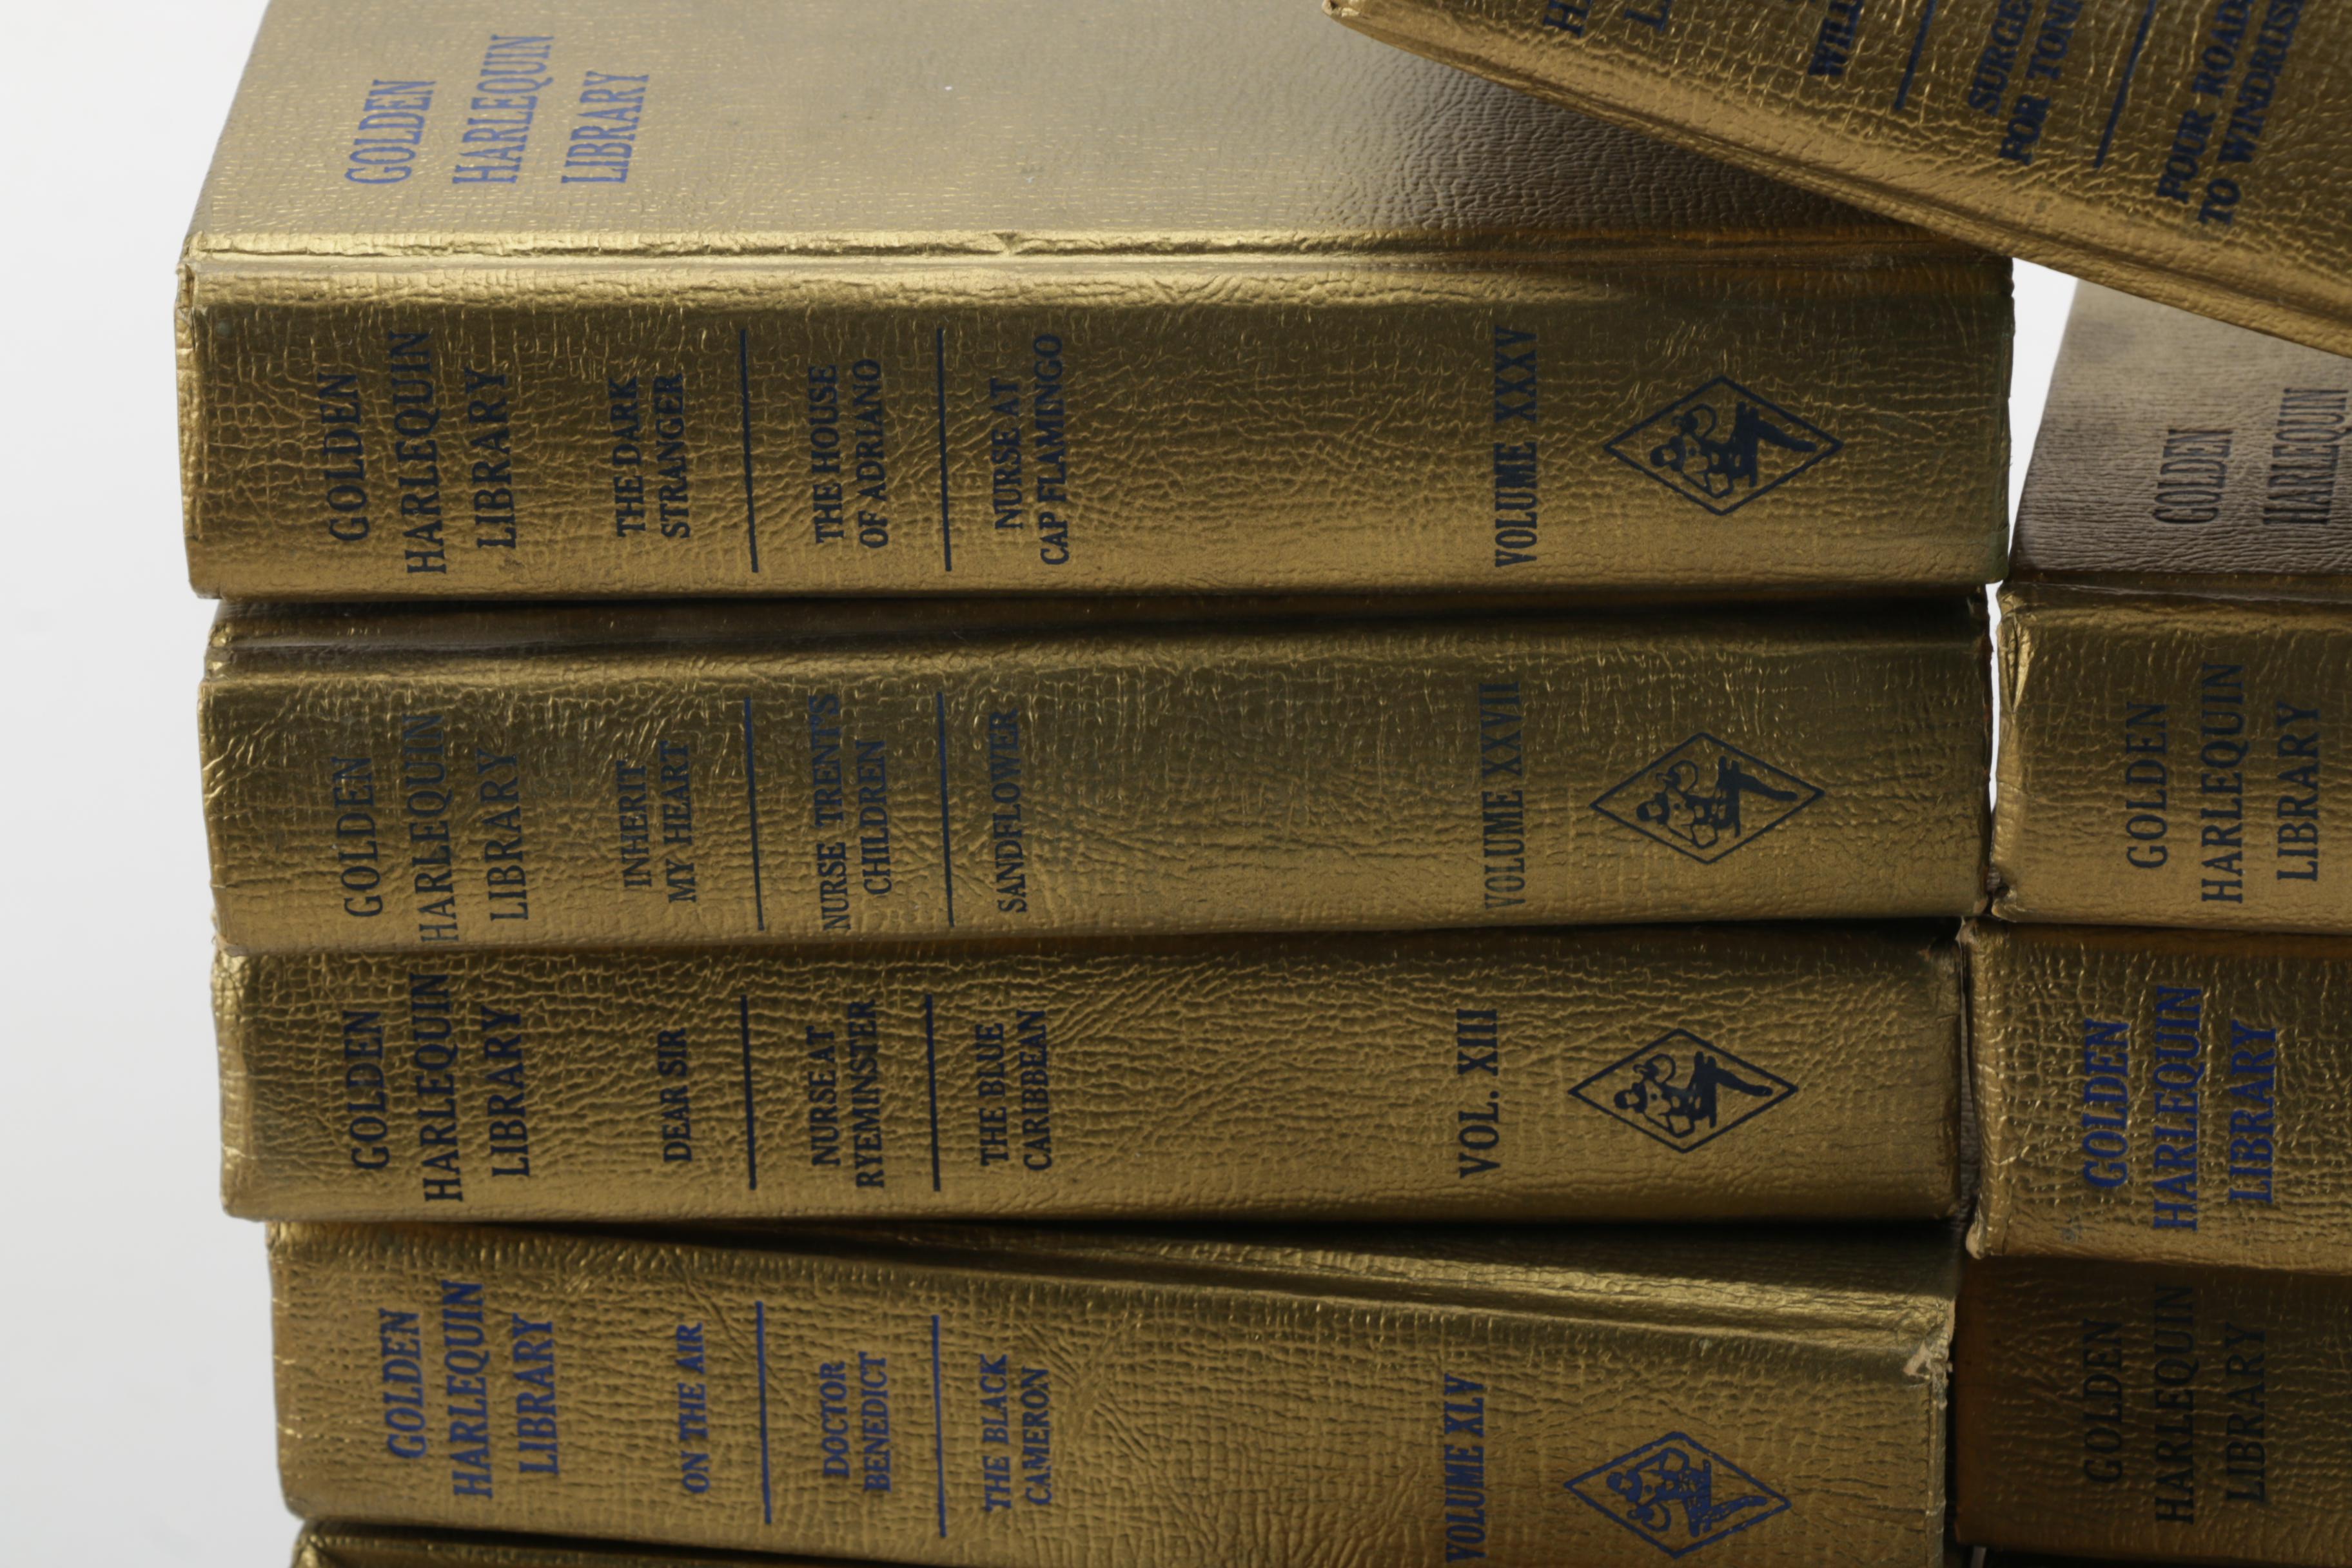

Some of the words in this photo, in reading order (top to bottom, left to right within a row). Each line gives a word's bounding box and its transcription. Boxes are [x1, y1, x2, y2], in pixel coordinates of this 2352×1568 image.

[344, 79, 436, 184] GOLDEN
[452, 34, 554, 184] HARLEQUIN
[561, 71, 649, 184] LIBRARY
[1999, 95, 2051, 165] FOR
[2156, 110, 2216, 204] FOUR
[2193, 0, 2253, 99] ROAD
[2217, 0, 2305, 164] WINDRUS
[2198, 179, 2242, 226] TO
[608, 376, 642, 466] DARK
[808, 364, 840, 474] HOUSE
[852, 358, 887, 502] ADRIANO
[990, 378, 1021, 418] AT
[1034, 333, 1067, 503] FLAMINGO
[1494, 325, 1537, 423] XXXV
[317, 371, 370, 542] GOLDEN
[389, 329, 447, 574] HARLEQUIN
[464, 367, 516, 549] LIBRARY
[612, 475, 646, 538] THE
[653, 373, 691, 538] STRANGER
[813, 482, 845, 544] THE
[992, 427, 1023, 530] NURSE
[1494, 442, 1538, 567] VOLUME
[2152, 429, 2233, 524] GOLDEN
[2262, 388, 2352, 525] HARLEQUIN
[858, 510, 889, 548] OF
[1039, 511, 1070, 565] CAP
[808, 693, 844, 828] TRENT'S
[1479, 681, 1523, 777] XXVII
[2126, 701, 2168, 868] GOLDEN
[2200, 662, 2249, 903] HARLEQUIN
[2277, 701, 2318, 881] LIBRARY
[331, 756, 384, 917] GOLDEN
[402, 714, 458, 942] HARLEQUIN
[476, 748, 529, 921] LIBRARY
[616, 760, 652, 888] INHERIT
[660, 740, 692, 846] HEART
[855, 740, 892, 895] CHILDREN
[989, 709, 1027, 913] SANDFLOWER
[1482, 789, 1525, 909] VOLUME
[665, 858, 696, 903] MY
[817, 841, 851, 931] NURSE
[342, 1010, 390, 1170] GOLDEN
[409, 972, 463, 1202] HARLEQUIN
[481, 1005, 530, 1177] LIBRARY
[656, 1028, 688, 1077] SIR
[805, 1025, 836, 1064] AT
[848, 998, 885, 1189] RYEMINSTER
[975, 1023, 1006, 1099] BLUE
[1016, 1009, 1053, 1171] CARIBBEAN
[1456, 1008, 1498, 1075] XIII
[2082, 1019, 2130, 1188] GOLDEN
[660, 1084, 692, 1162] DEAR
[808, 1070, 841, 1166] NURSE
[979, 1106, 1009, 1166] THE
[1458, 1090, 1500, 1179] VOL.
[2153, 986, 2205, 1231] HARLEQUIN
[2229, 1019, 2277, 1204] LIBRARY
[378, 1308, 427, 1459] GOLDEN
[441, 1280, 493, 1499] HARLEQUIN
[513, 1313, 560, 1475] LIBRARY
[676, 1322, 706, 1375] AIR
[678, 1382, 709, 1440] THE
[979, 1354, 1010, 1445] BLACK
[1444, 1373, 1485, 1438] XLV
[2083, 1318, 2122, 1484] GOLDEN
[2155, 1284, 2199, 1524] HARLEQUIN
[680, 1451, 710, 1494] ON
[819, 1360, 850, 1478] DOCTOR
[859, 1351, 892, 1492] BENEDICT
[1021, 1366, 1052, 1505] CAMERON
[2224, 1321, 2266, 1504] LIBRARY
[984, 1455, 1012, 1512] THE
[1444, 1444, 1486, 1563] VOLUME
